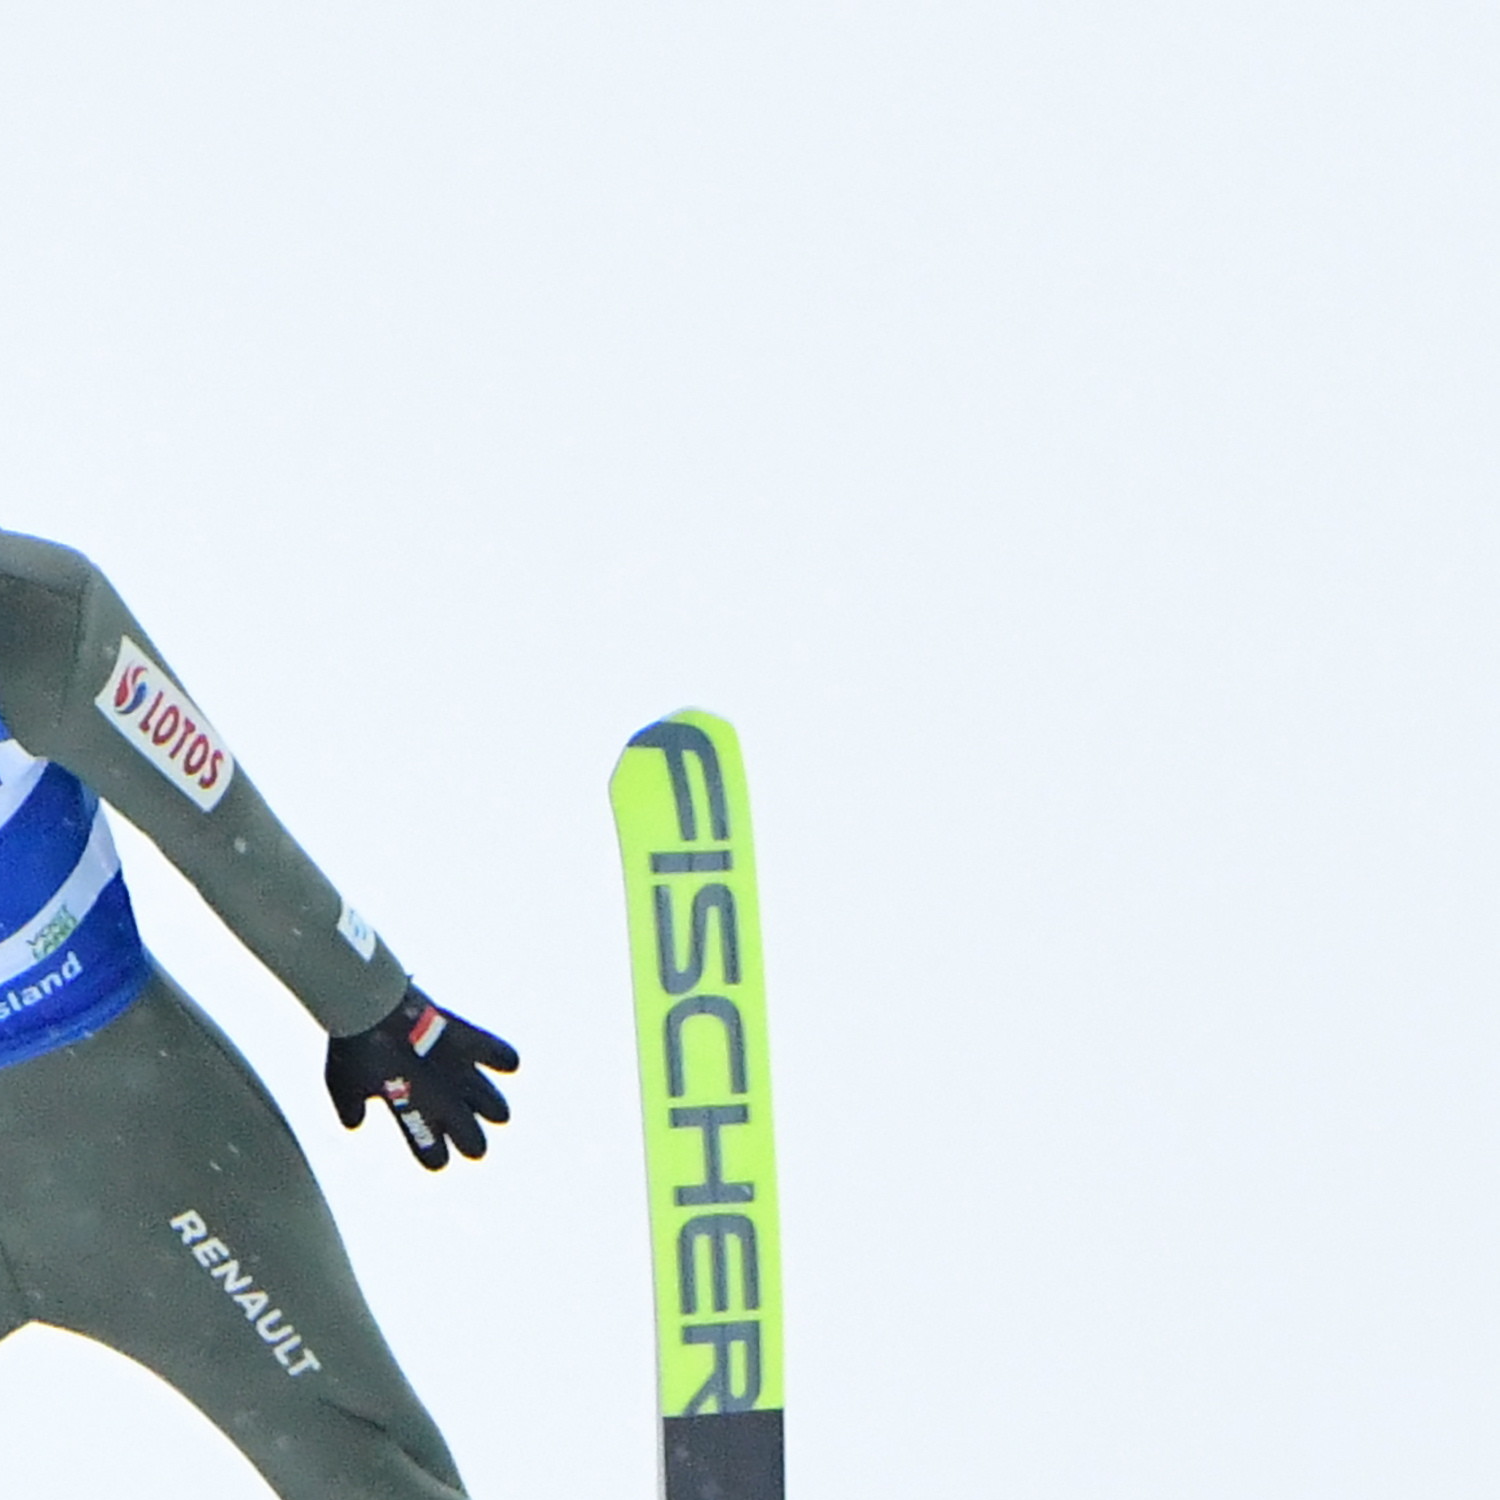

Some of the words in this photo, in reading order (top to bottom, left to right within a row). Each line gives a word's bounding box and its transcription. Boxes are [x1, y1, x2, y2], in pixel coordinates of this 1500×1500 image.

[139, 690, 225, 790] LOTOS
[626, 720, 765, 1418] FISCHER
[169, 1208, 321, 1377] RENAULT
